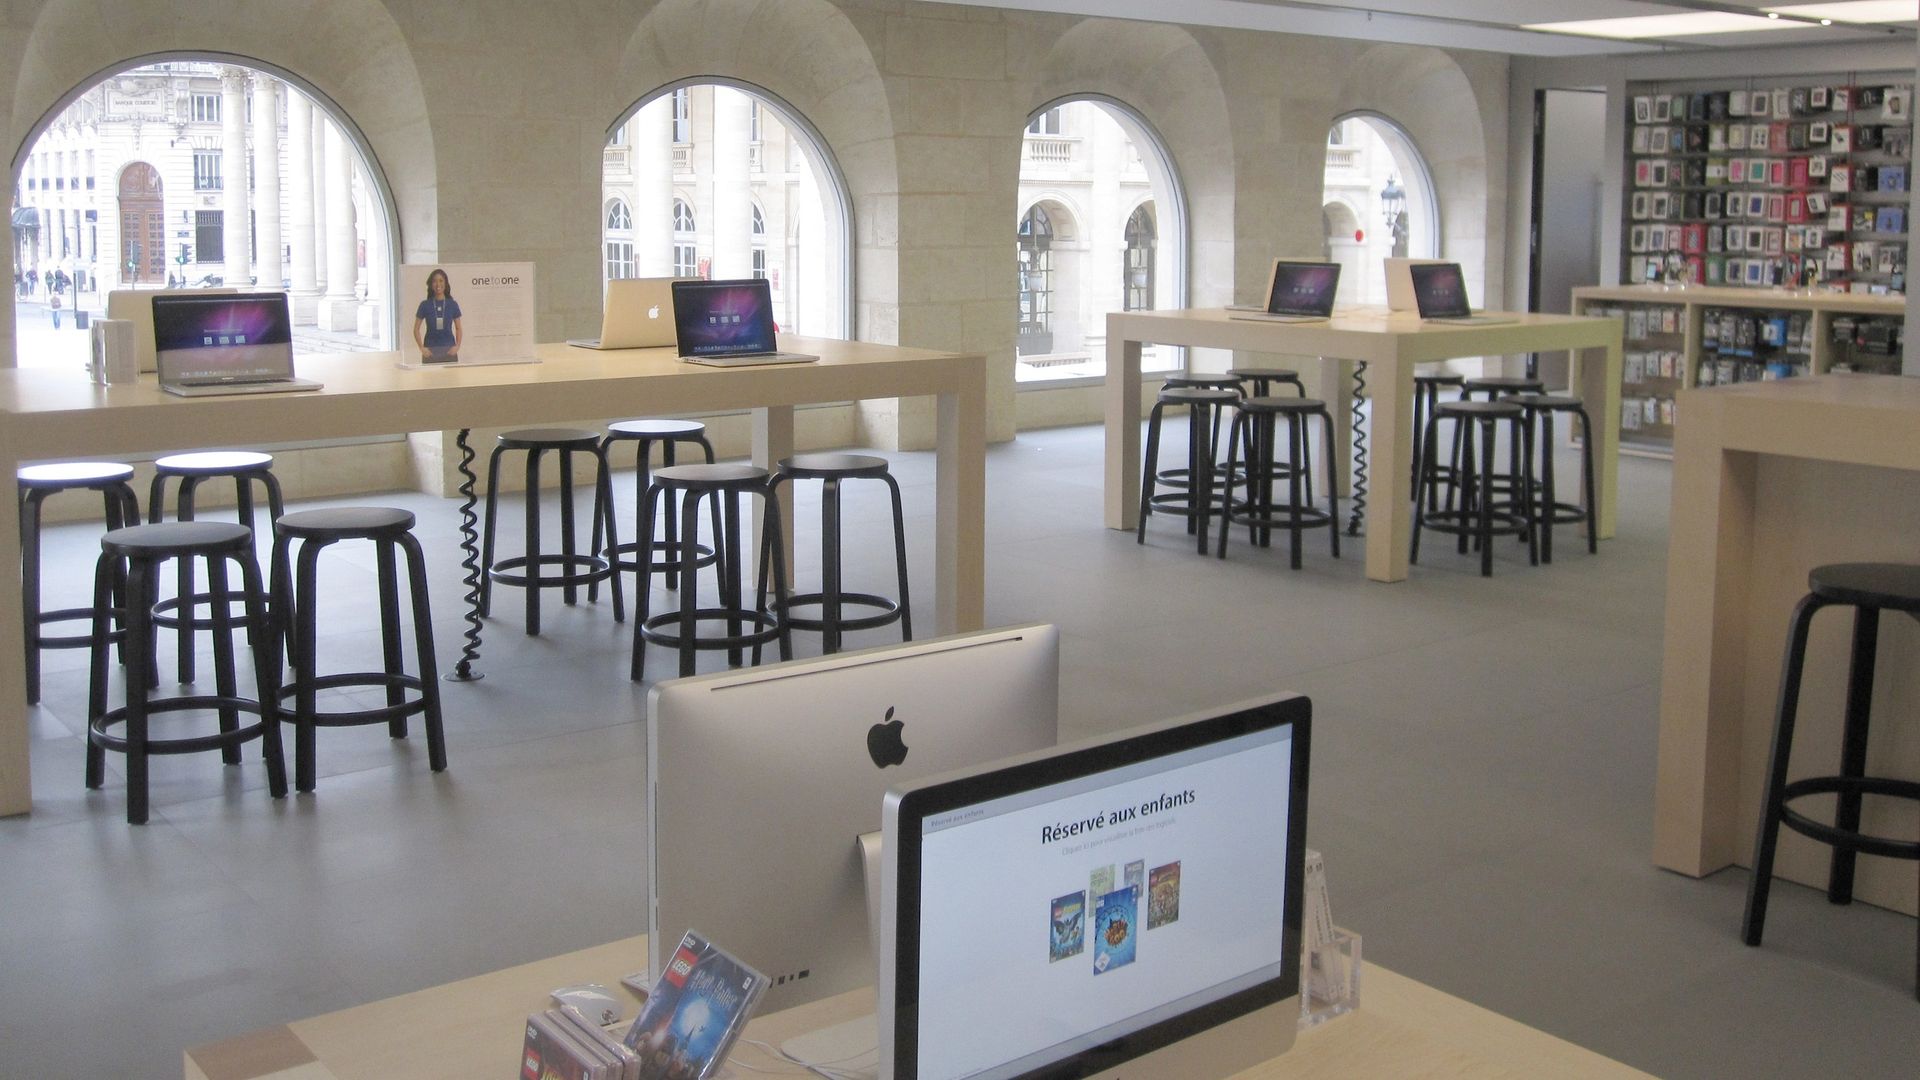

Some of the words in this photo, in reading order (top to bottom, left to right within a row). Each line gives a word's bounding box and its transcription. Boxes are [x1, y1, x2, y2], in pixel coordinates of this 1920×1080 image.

[472, 277, 490, 286] one
[501, 276, 519, 285] one
[1042, 810, 1105, 844] Réservé
[1109, 806, 1136, 825] aux
[1140, 789, 1195, 816] enfants
[673, 960, 691, 976] LEGO
[526, 1057, 539, 1072] LEGO
